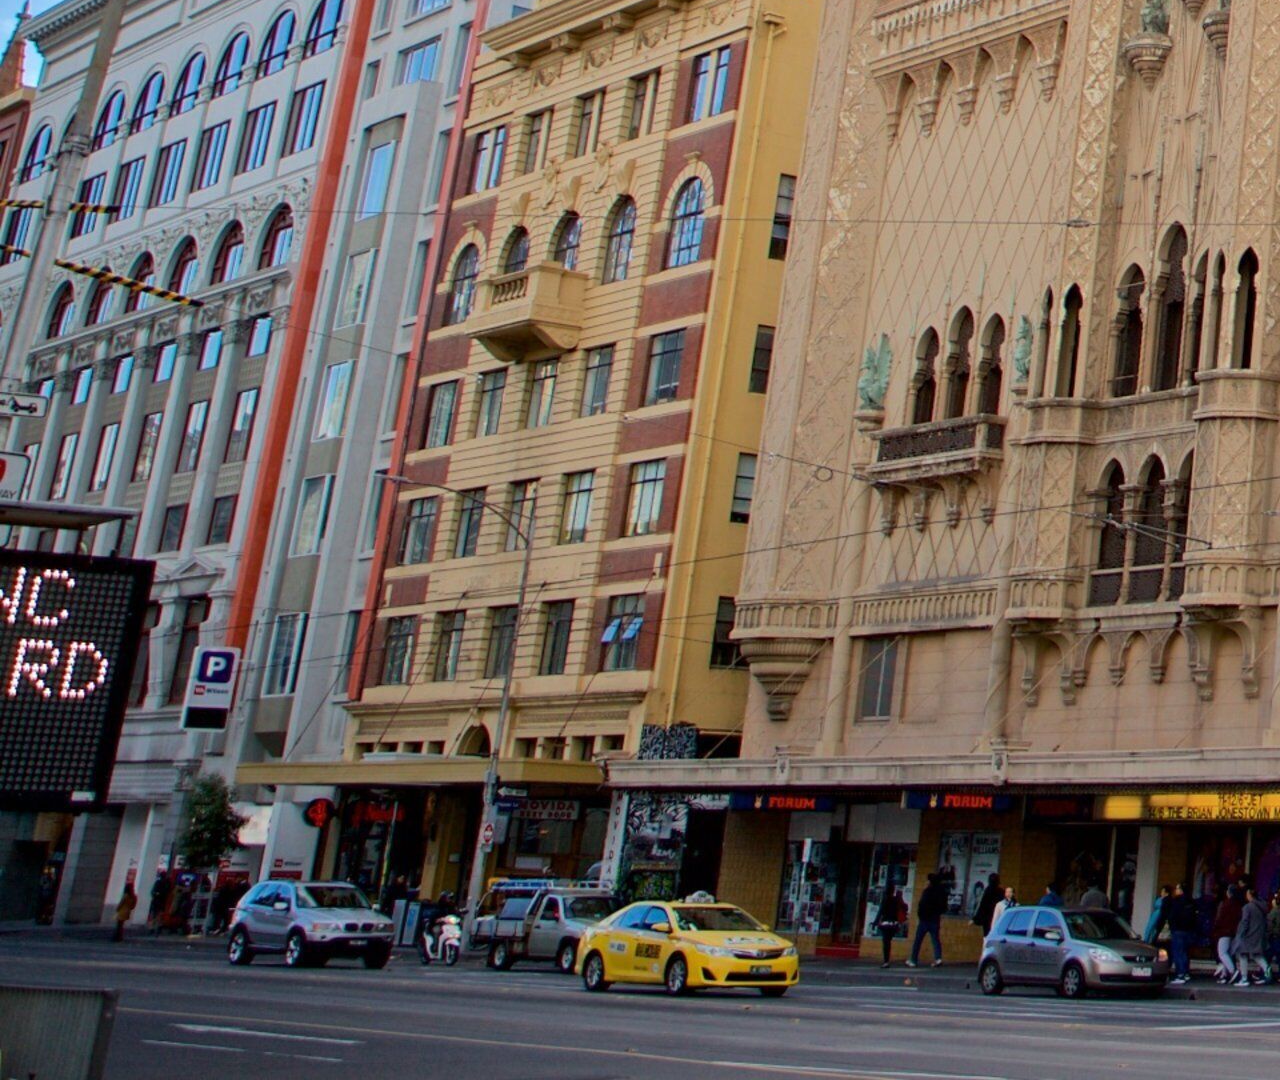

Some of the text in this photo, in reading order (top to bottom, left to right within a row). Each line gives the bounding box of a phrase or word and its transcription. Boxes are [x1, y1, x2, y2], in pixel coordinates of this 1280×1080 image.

[206, 656, 227, 677] P
[768, 797, 815, 809] FORUM
[943, 795, 992, 808] FORUM
[1168, 806, 1183, 819] THE
[1187, 806, 1212, 819] BRIAN
[1216, 806, 1270, 819] JONESTOWN
